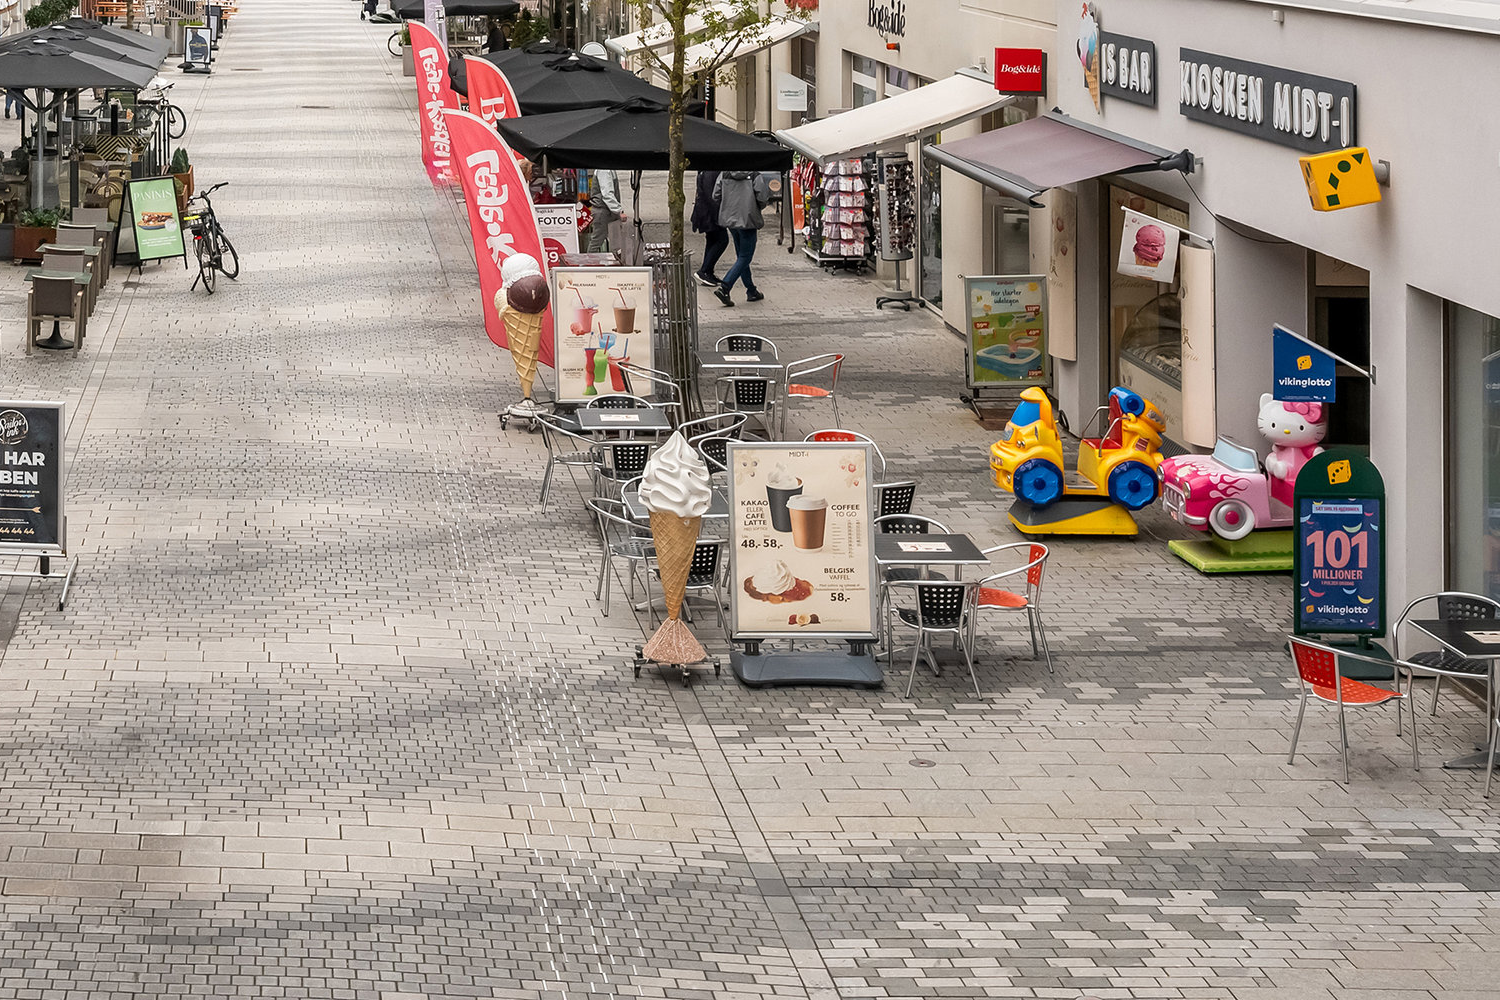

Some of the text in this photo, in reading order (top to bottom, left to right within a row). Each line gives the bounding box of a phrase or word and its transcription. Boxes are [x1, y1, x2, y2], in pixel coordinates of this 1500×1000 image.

[1001, 63, 1041, 74] Bog&idé
[1102, 43, 1150, 94] IS BAR
[1179, 60, 1350, 148] KIOSKEN MIDT-I
[133, 190, 172, 201] PANINIS
[538, 216, 572, 226] FOTOS
[1279, 377, 1332, 388] vikinglotto
[5, 451, 45, 466] HAR
[741, 539, 783, 549] 48,- 58,-
[1306, 530, 1368, 568] 101
[1312, 569, 1363, 580] MILLIONER
[830, 592, 851, 602] 58,-
[1317, 605, 1368, 615] vikinglotto
